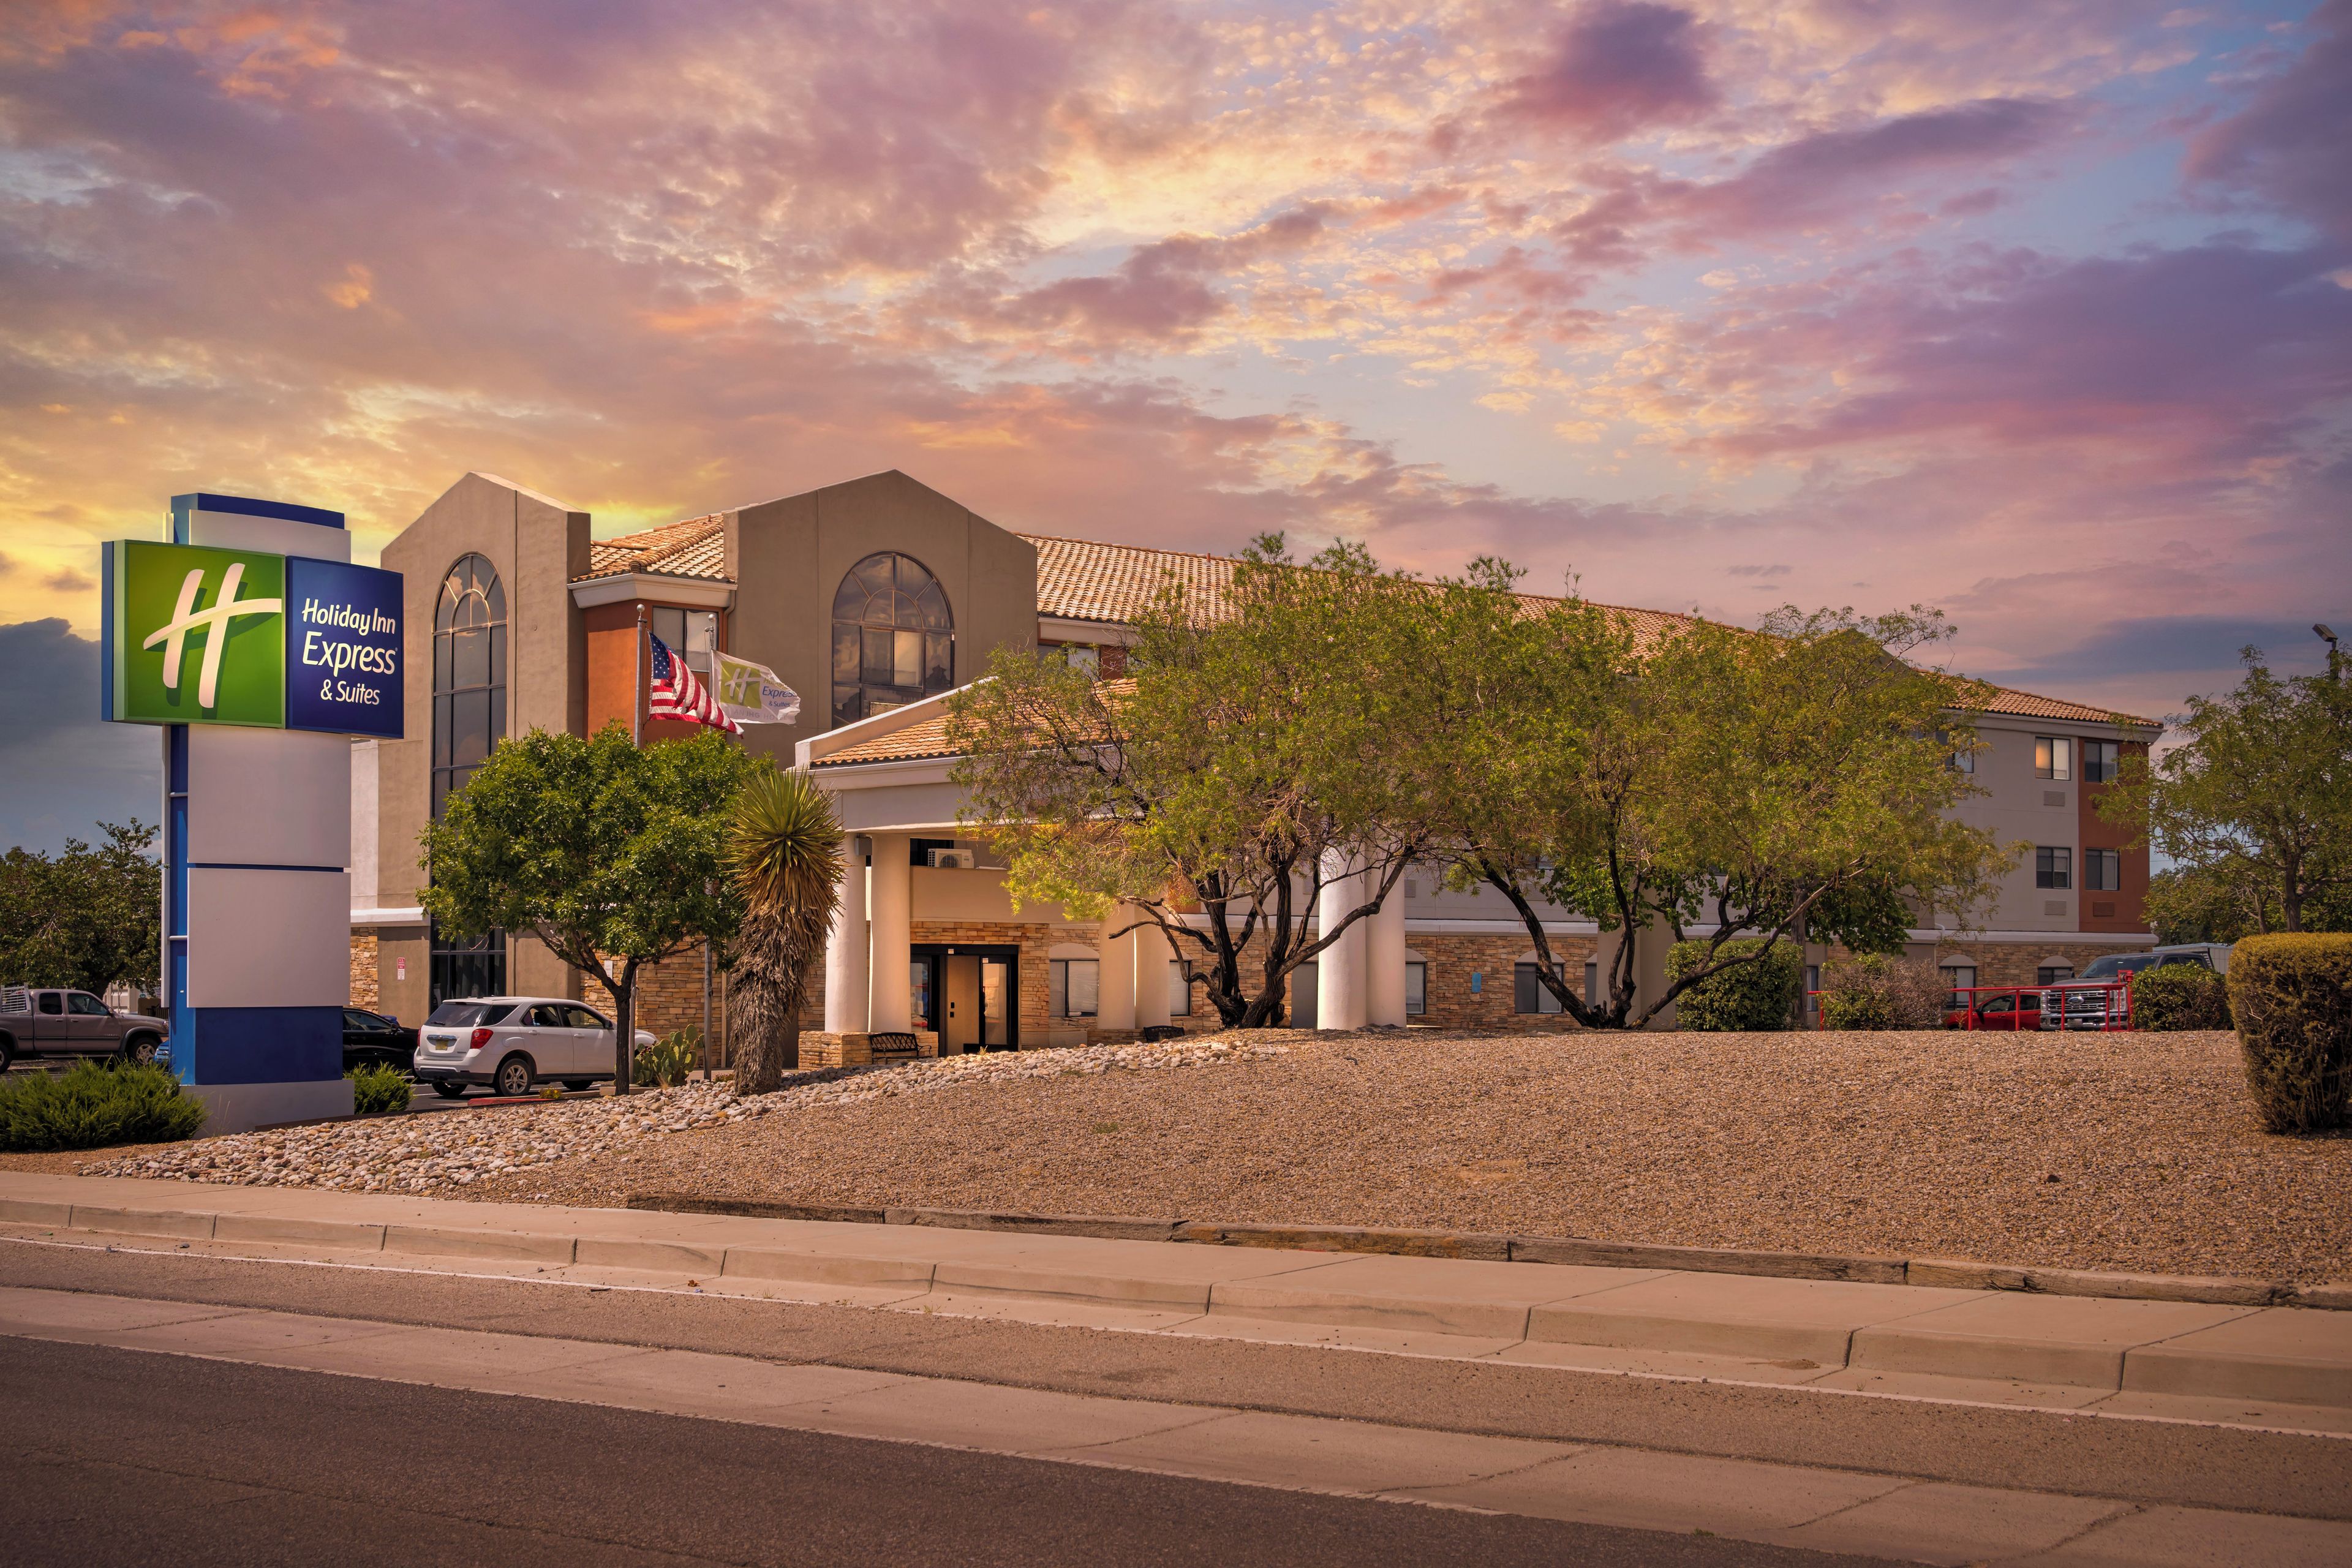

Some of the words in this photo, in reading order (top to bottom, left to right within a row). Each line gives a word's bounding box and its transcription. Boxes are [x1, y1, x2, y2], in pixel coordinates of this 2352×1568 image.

[301, 598, 371, 636] Holiday
[372, 608, 396, 635] Inn
[302, 630, 396, 677] Express
[320, 679, 333, 701] &
[336, 680, 380, 705] Suites
[747, 710, 760, 718] IHG
